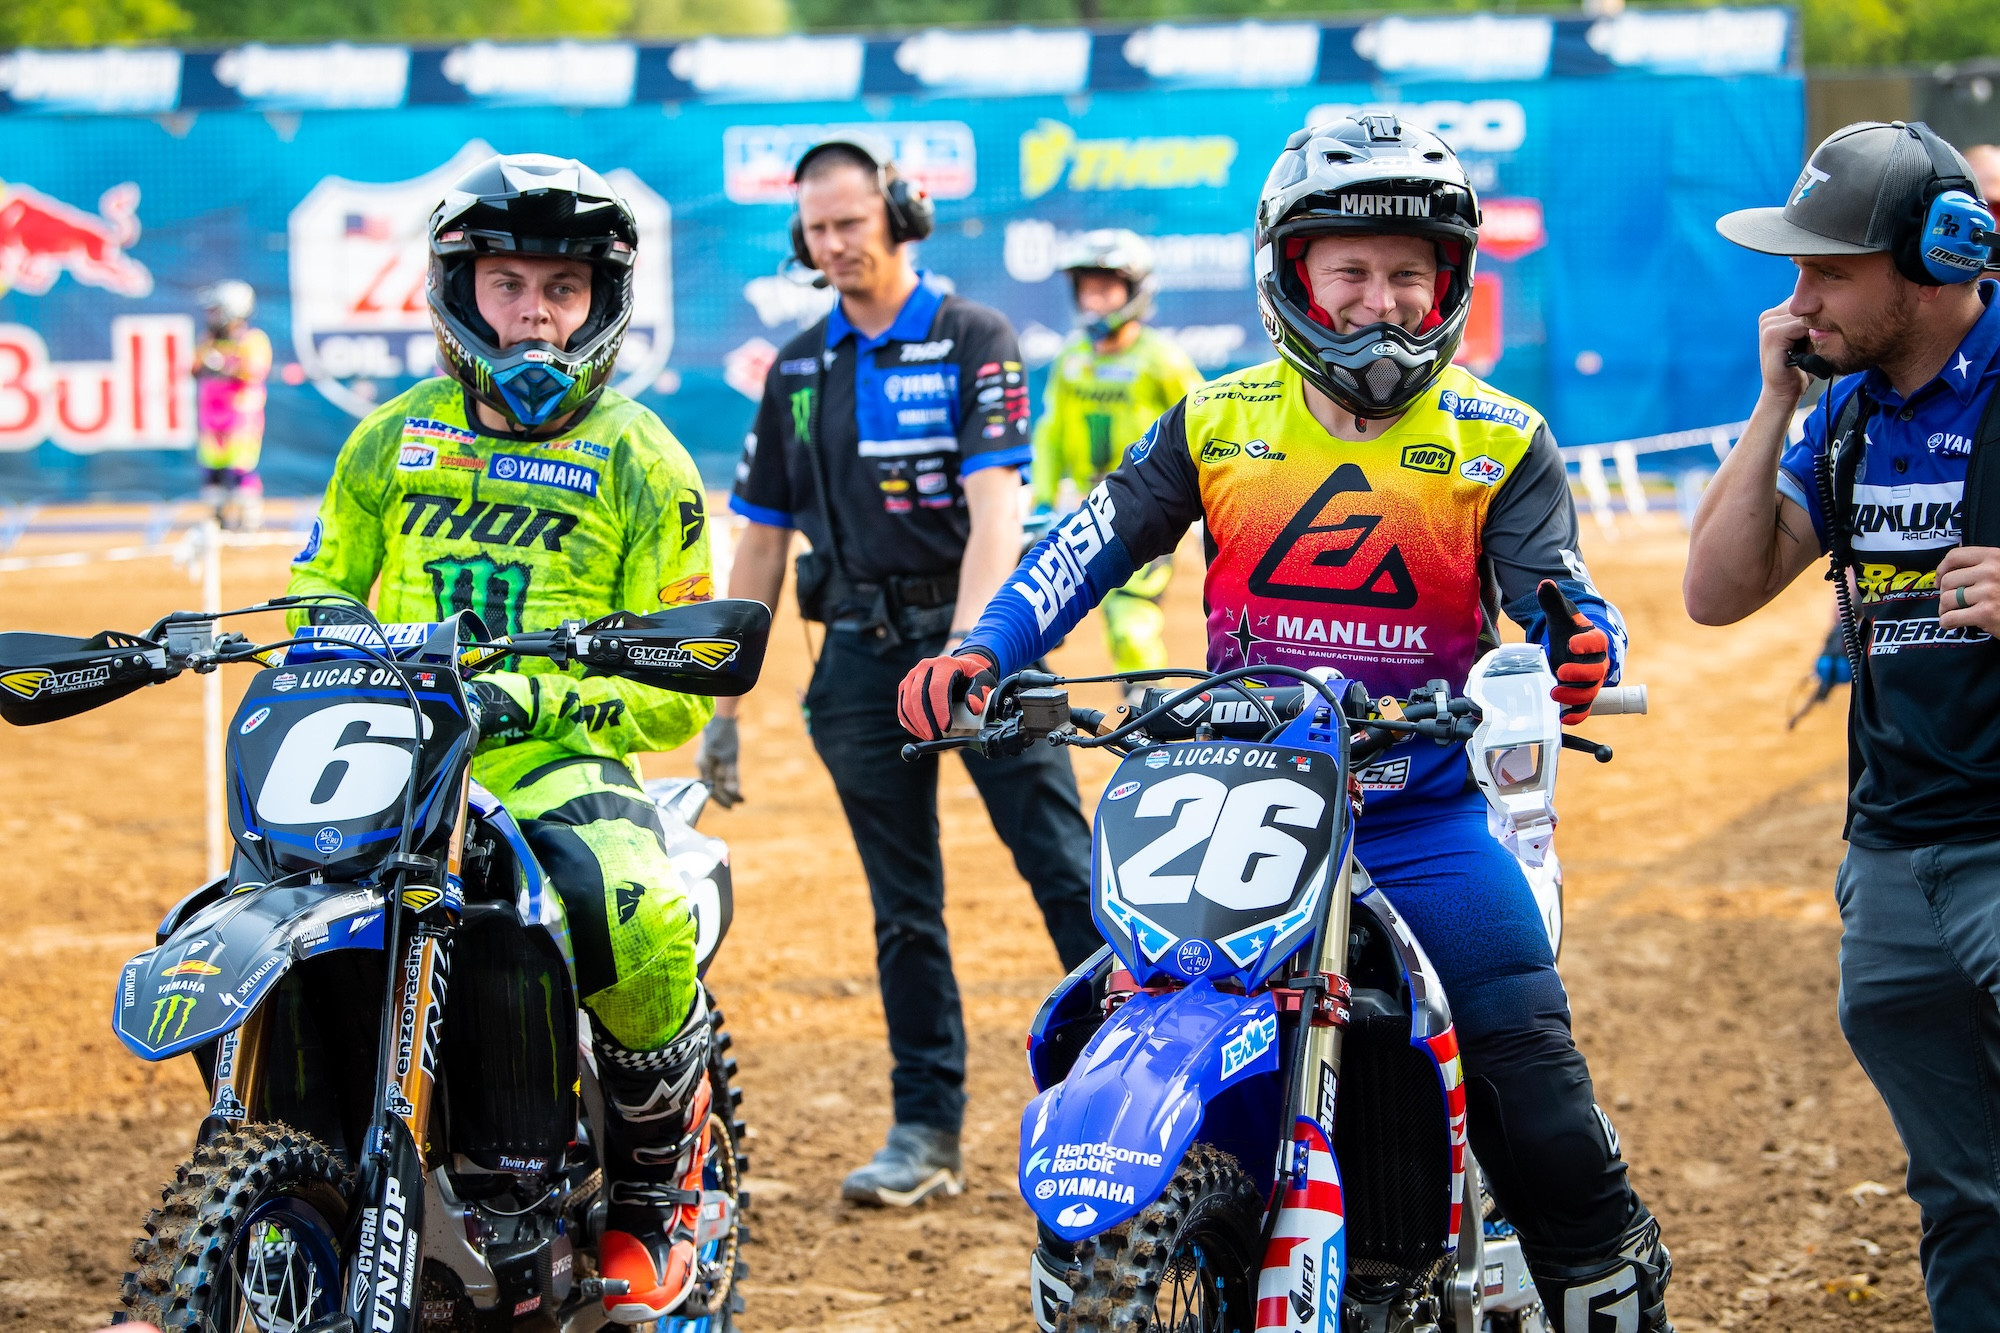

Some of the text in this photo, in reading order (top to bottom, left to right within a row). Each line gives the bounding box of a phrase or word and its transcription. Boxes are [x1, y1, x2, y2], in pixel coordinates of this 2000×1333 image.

[1340, 194, 1431, 217] MARTIN
[1929, 247, 1983, 268] MERGE
[1213, 392, 1282, 402] DUNLOP
[1459, 400, 1525, 426] YAMAHA
[1409, 451, 1447, 469] 100%
[518, 461, 593, 492] YAMAHA
[400, 493, 580, 552] THOR
[1902, 529, 1962, 541] RACING
[1276, 615, 1428, 650] MANLUK
[628, 646, 693, 662] CYCRA
[1276, 646, 1425, 664] GLOBAL MANUFACTURING SOLUTIONS
[40, 665, 110, 690] CYCRA
[51, 680, 105, 695] STEALTH DX
[300, 667, 366, 689] LUCAS
[369, 668, 403, 687] OIL
[257, 702, 434, 825] 6
[1172, 747, 1240, 767] LUCAS
[1243, 749, 1276, 769] OIL
[1117, 772, 1326, 911] 26
[125, 968, 137, 1007] SPECIALIZED
[158, 980, 205, 994] YAMAHA
[237, 955, 280, 996] SPECIALIZED
[500, 1156, 545, 1170] Twin Air
[1051, 1155, 1116, 1175] Rabbit
[1055, 1142, 1162, 1167] Handsome
[1058, 1177, 1135, 1205] YAMAHA
[358, 1207, 378, 1273] CYCRA
[372, 1177, 406, 1333] UNLOP
[401, 1228, 418, 1310] BRAKING
[1302, 1253, 1314, 1303] UFO
